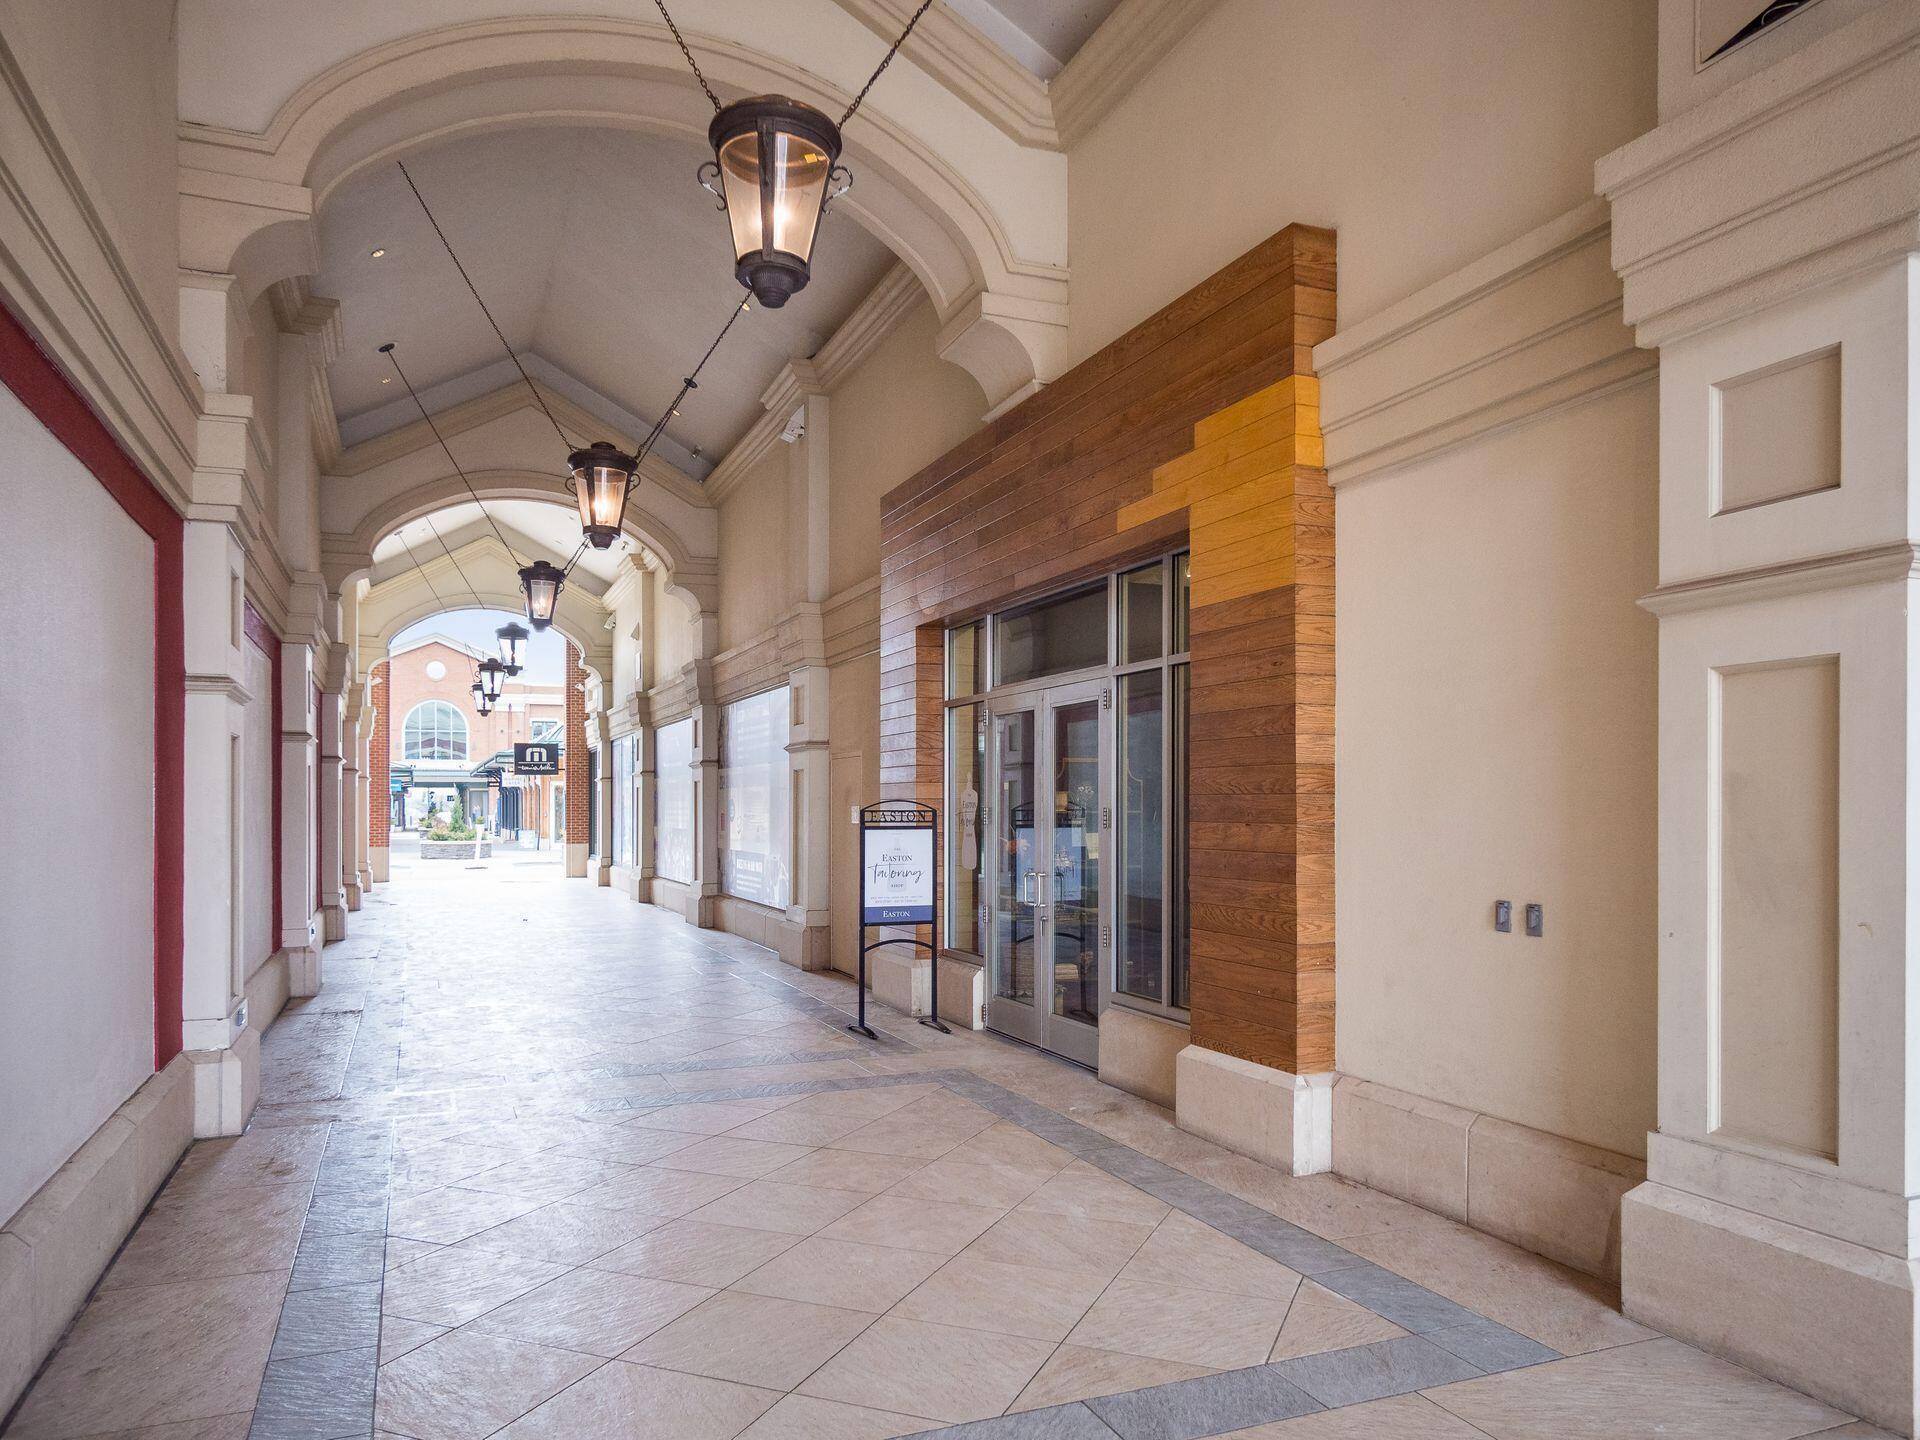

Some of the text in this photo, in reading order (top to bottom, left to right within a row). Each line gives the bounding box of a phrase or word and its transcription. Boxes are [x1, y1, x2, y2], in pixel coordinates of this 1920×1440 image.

[870, 811, 926, 822] EASTON
[882, 854, 913, 862] EASTON
[867, 863, 924, 884] Tailoring
